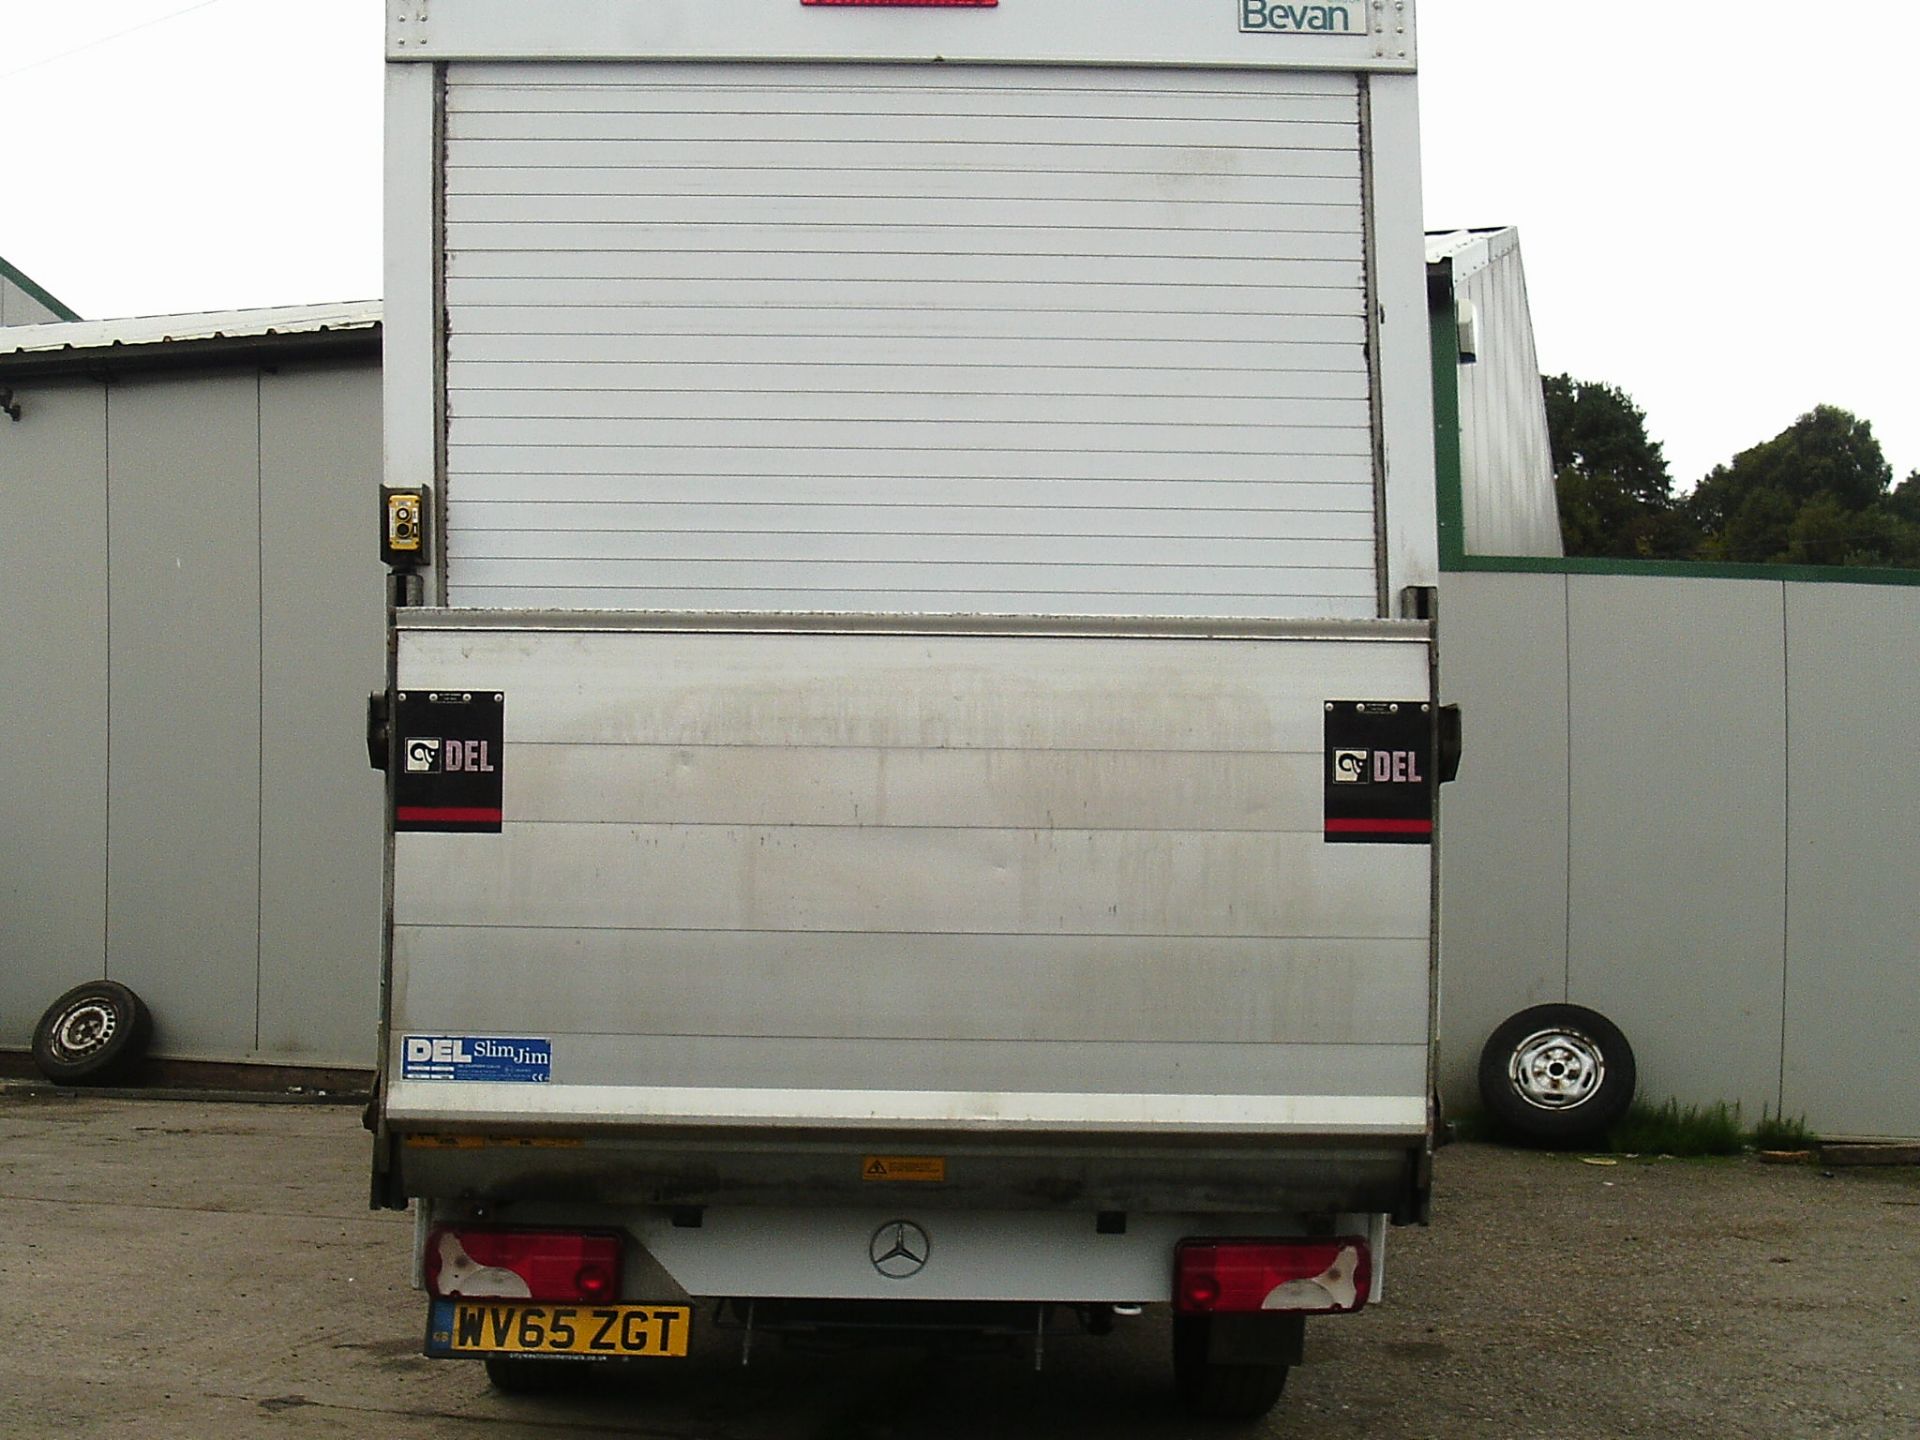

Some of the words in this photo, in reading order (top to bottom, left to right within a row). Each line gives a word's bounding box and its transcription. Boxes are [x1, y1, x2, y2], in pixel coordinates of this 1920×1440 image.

[1243, 0, 1349, 31] Bevan
[446, 740, 494, 772] DEL
[1373, 750, 1422, 783] DEL
[407, 1039, 472, 1063] DEL
[474, 1040, 515, 1058] Slim
[514, 1047, 549, 1065] Jim
[460, 1307, 578, 1350] WV65
[589, 1309, 680, 1352] ZGT
